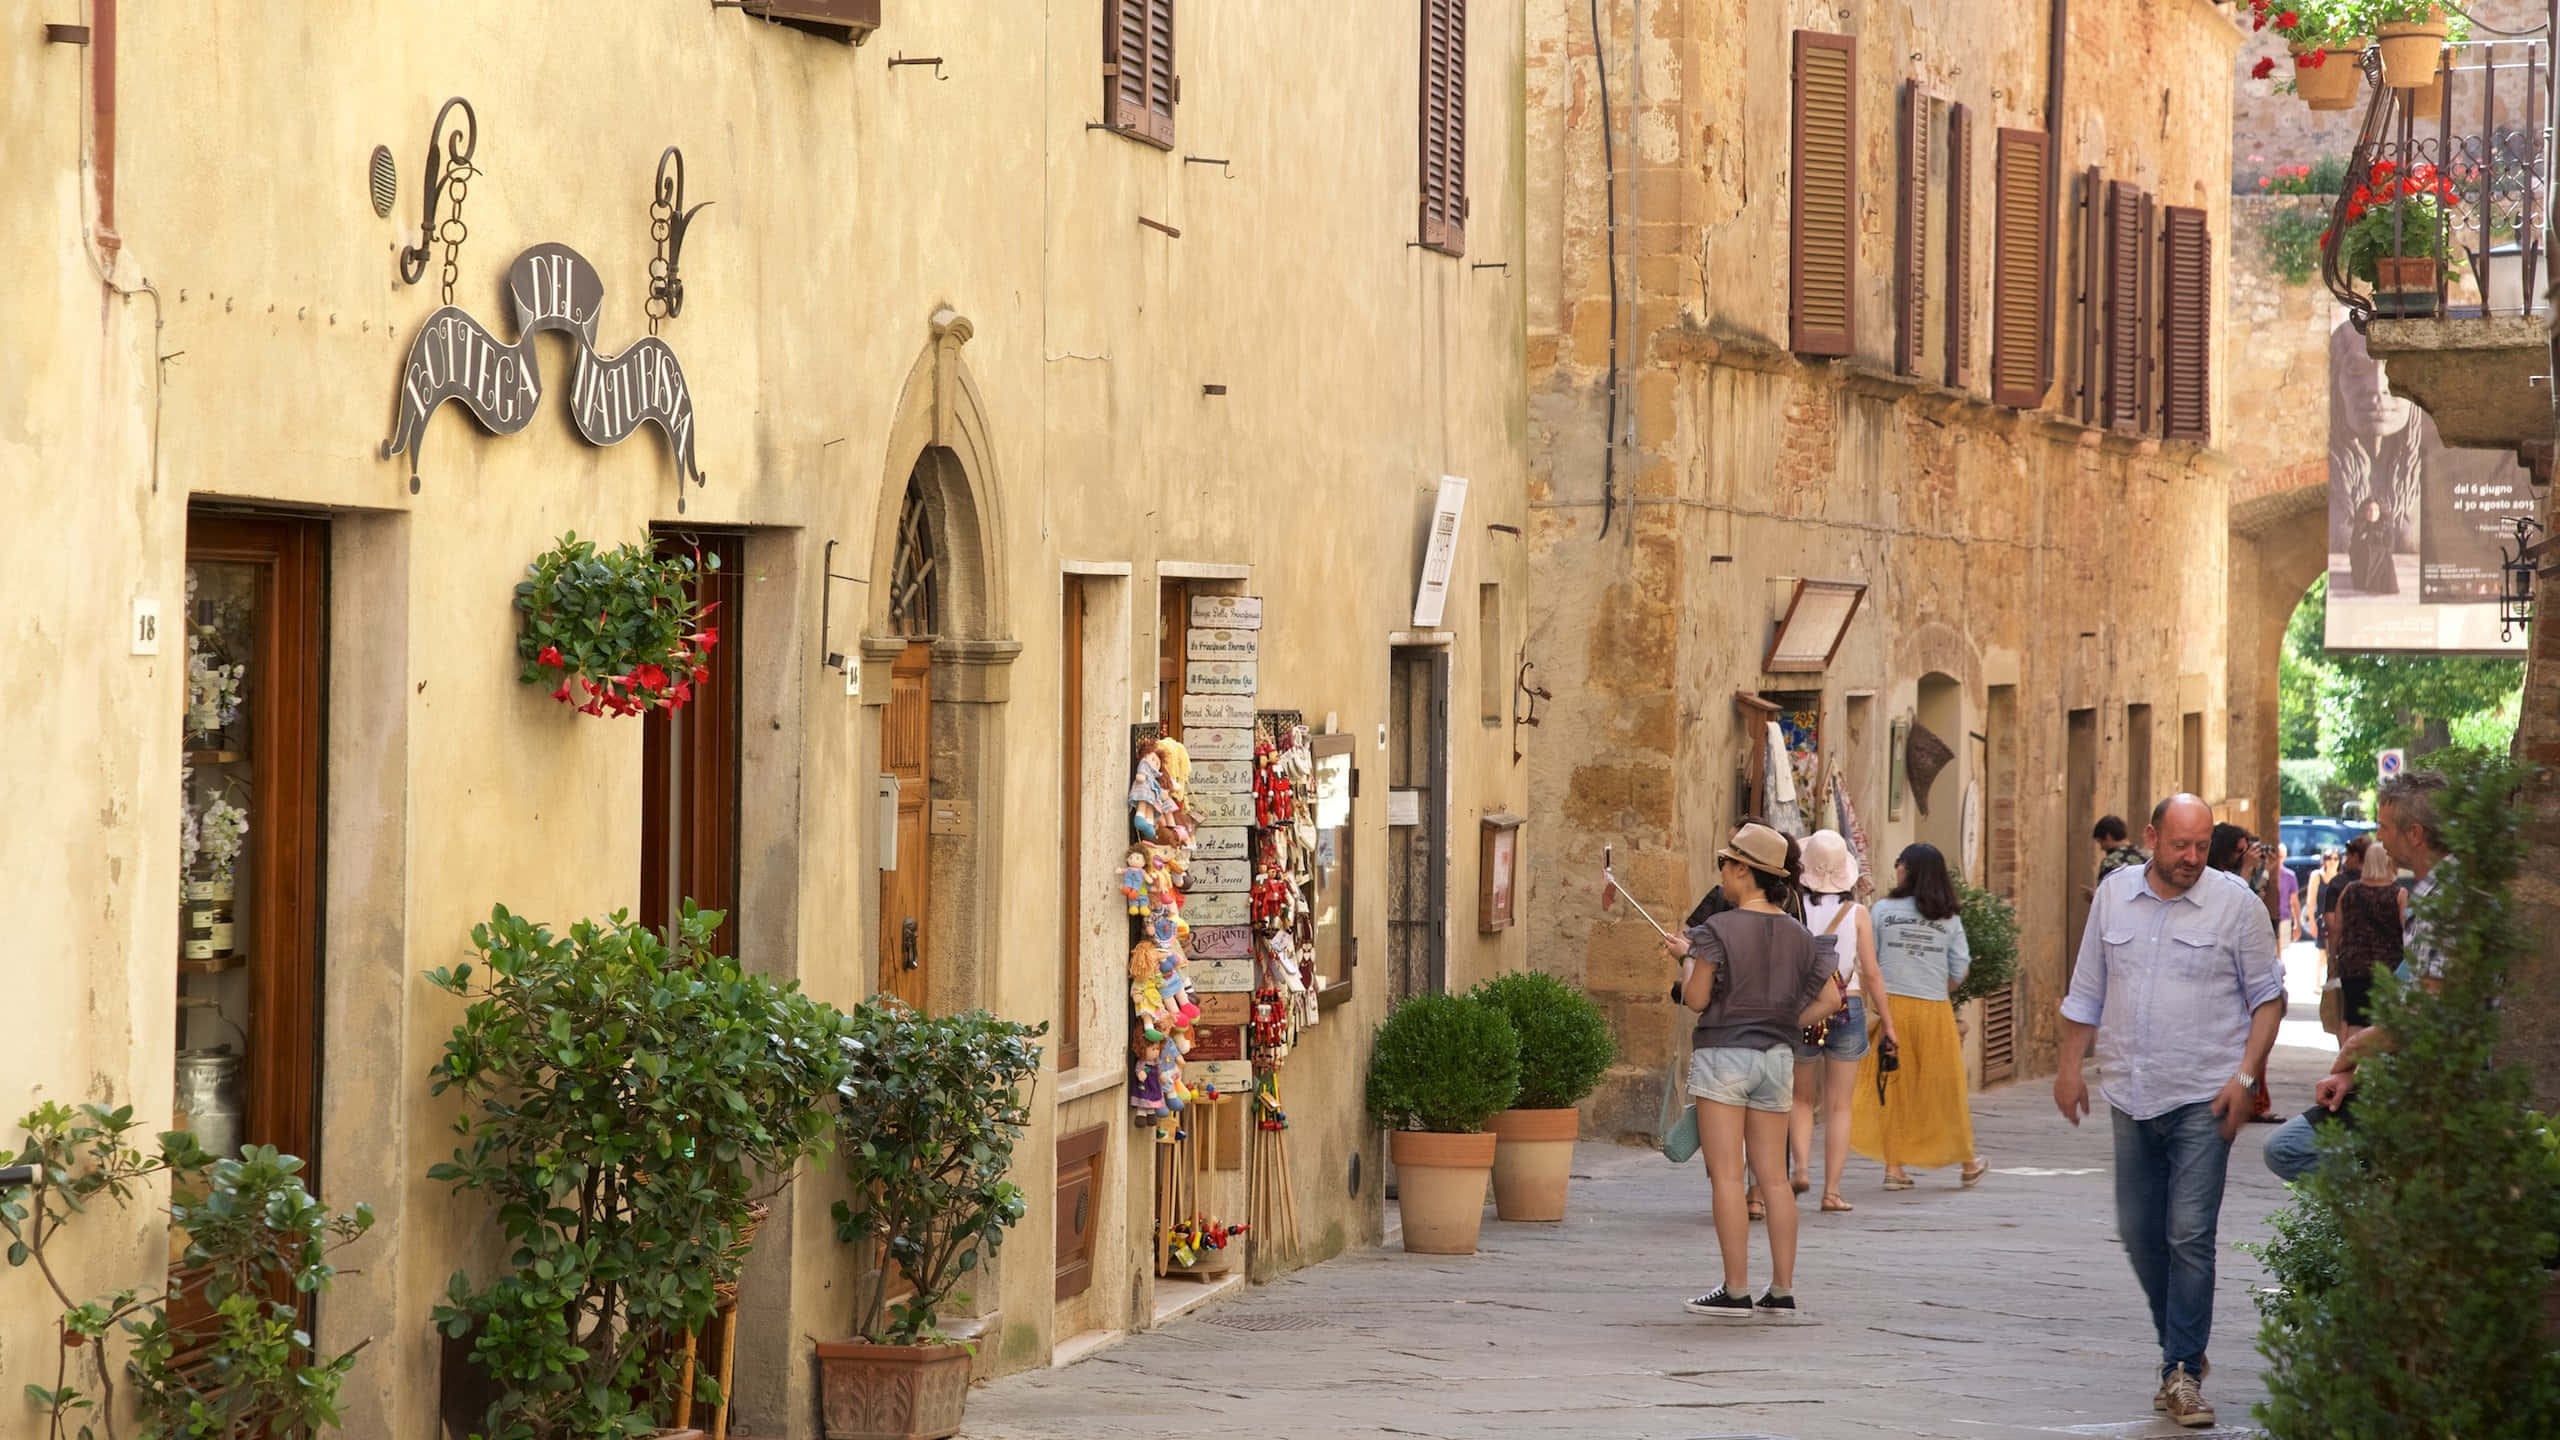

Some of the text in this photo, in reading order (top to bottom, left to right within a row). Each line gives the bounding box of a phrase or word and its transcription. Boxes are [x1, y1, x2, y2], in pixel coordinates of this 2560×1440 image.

[529, 255, 583, 324] DEL
[407, 317, 539, 422] BOTTEGA
[571, 345, 692, 465] NATURISTA
[2454, 483, 2513, 497] dal 6 giugno
[2454, 499, 2535, 512] al 30 agosto 2015
[139, 614, 156, 641] 18
[1187, 771, 1219, 785] abinetto
[1222, 770, 1237, 785] Del
[1220, 803, 1236, 817] Del
